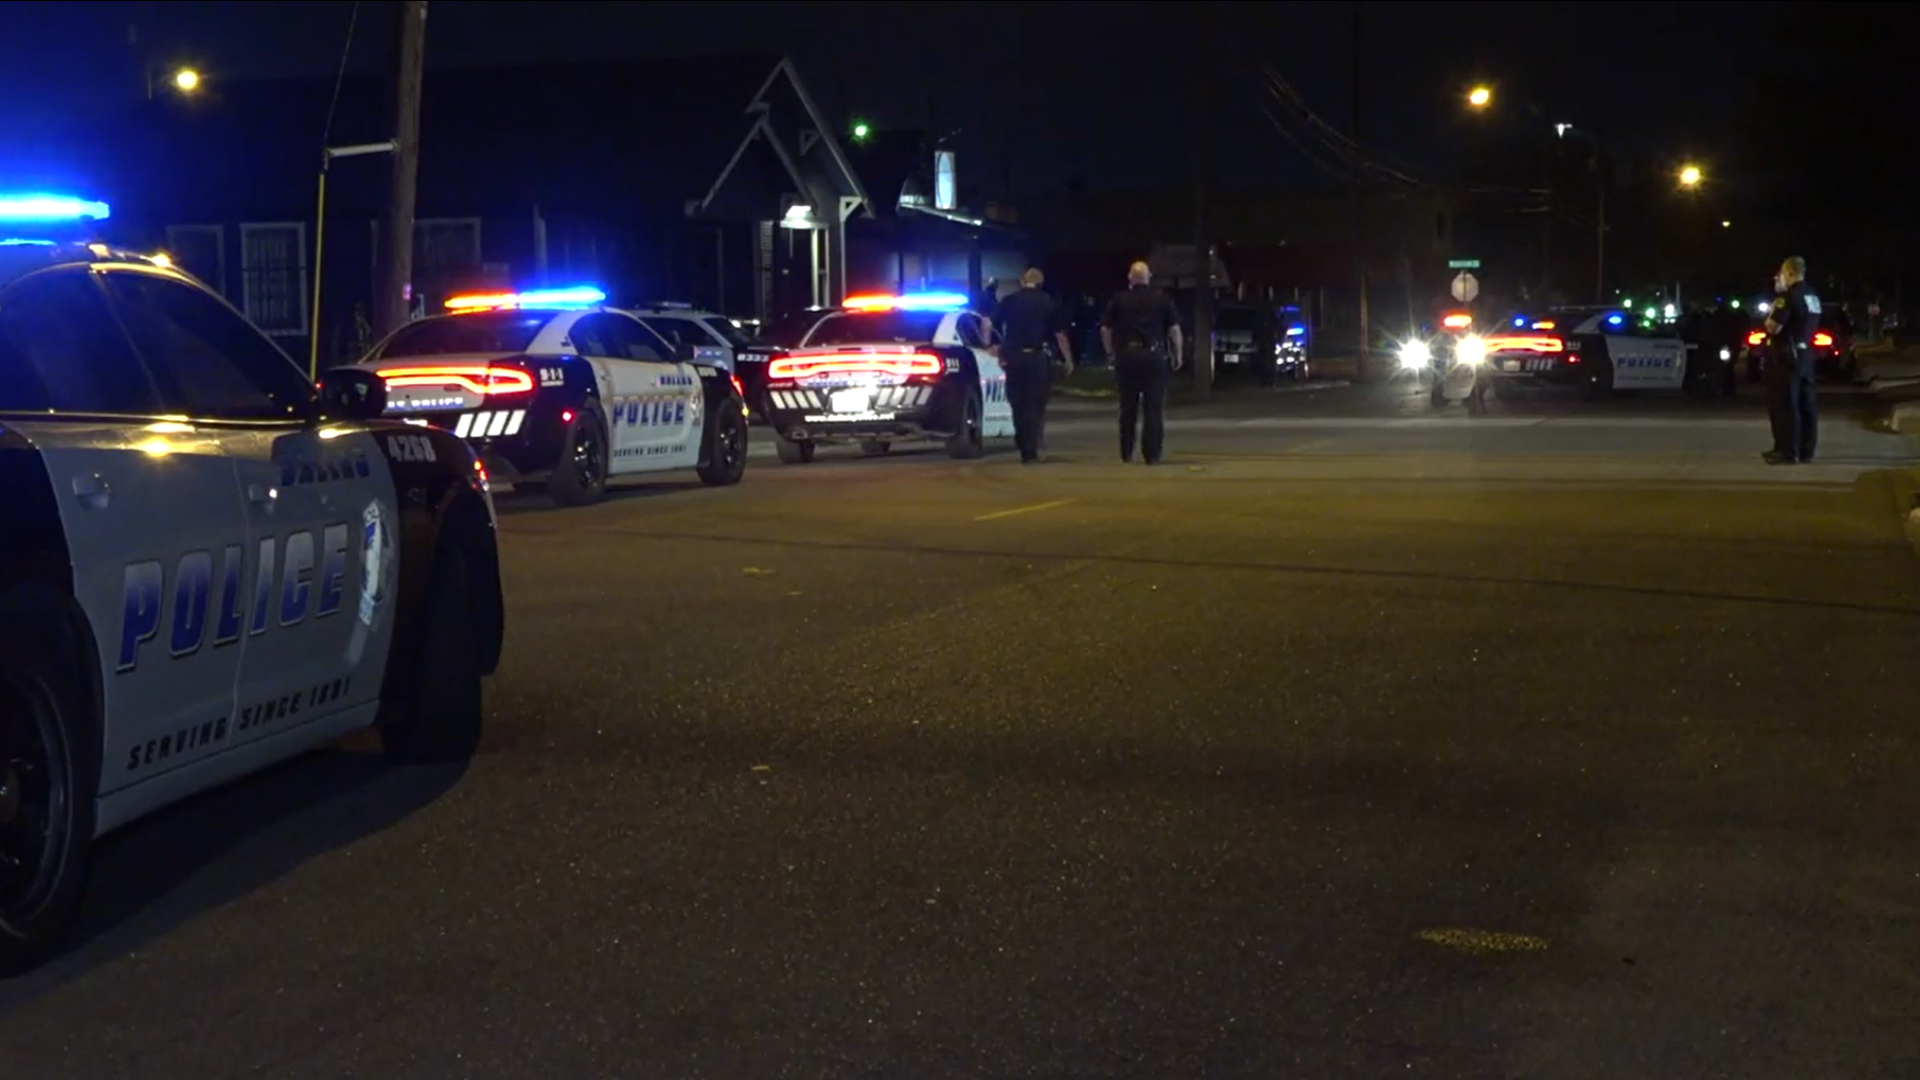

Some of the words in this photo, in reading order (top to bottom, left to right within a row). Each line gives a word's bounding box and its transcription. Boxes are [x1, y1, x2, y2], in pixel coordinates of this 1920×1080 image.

[613, 396, 686, 427] POLICE
[115, 522, 349, 675] POLICE
[127, 716, 227, 771] SERVING
[239, 691, 304, 730] SINCE
